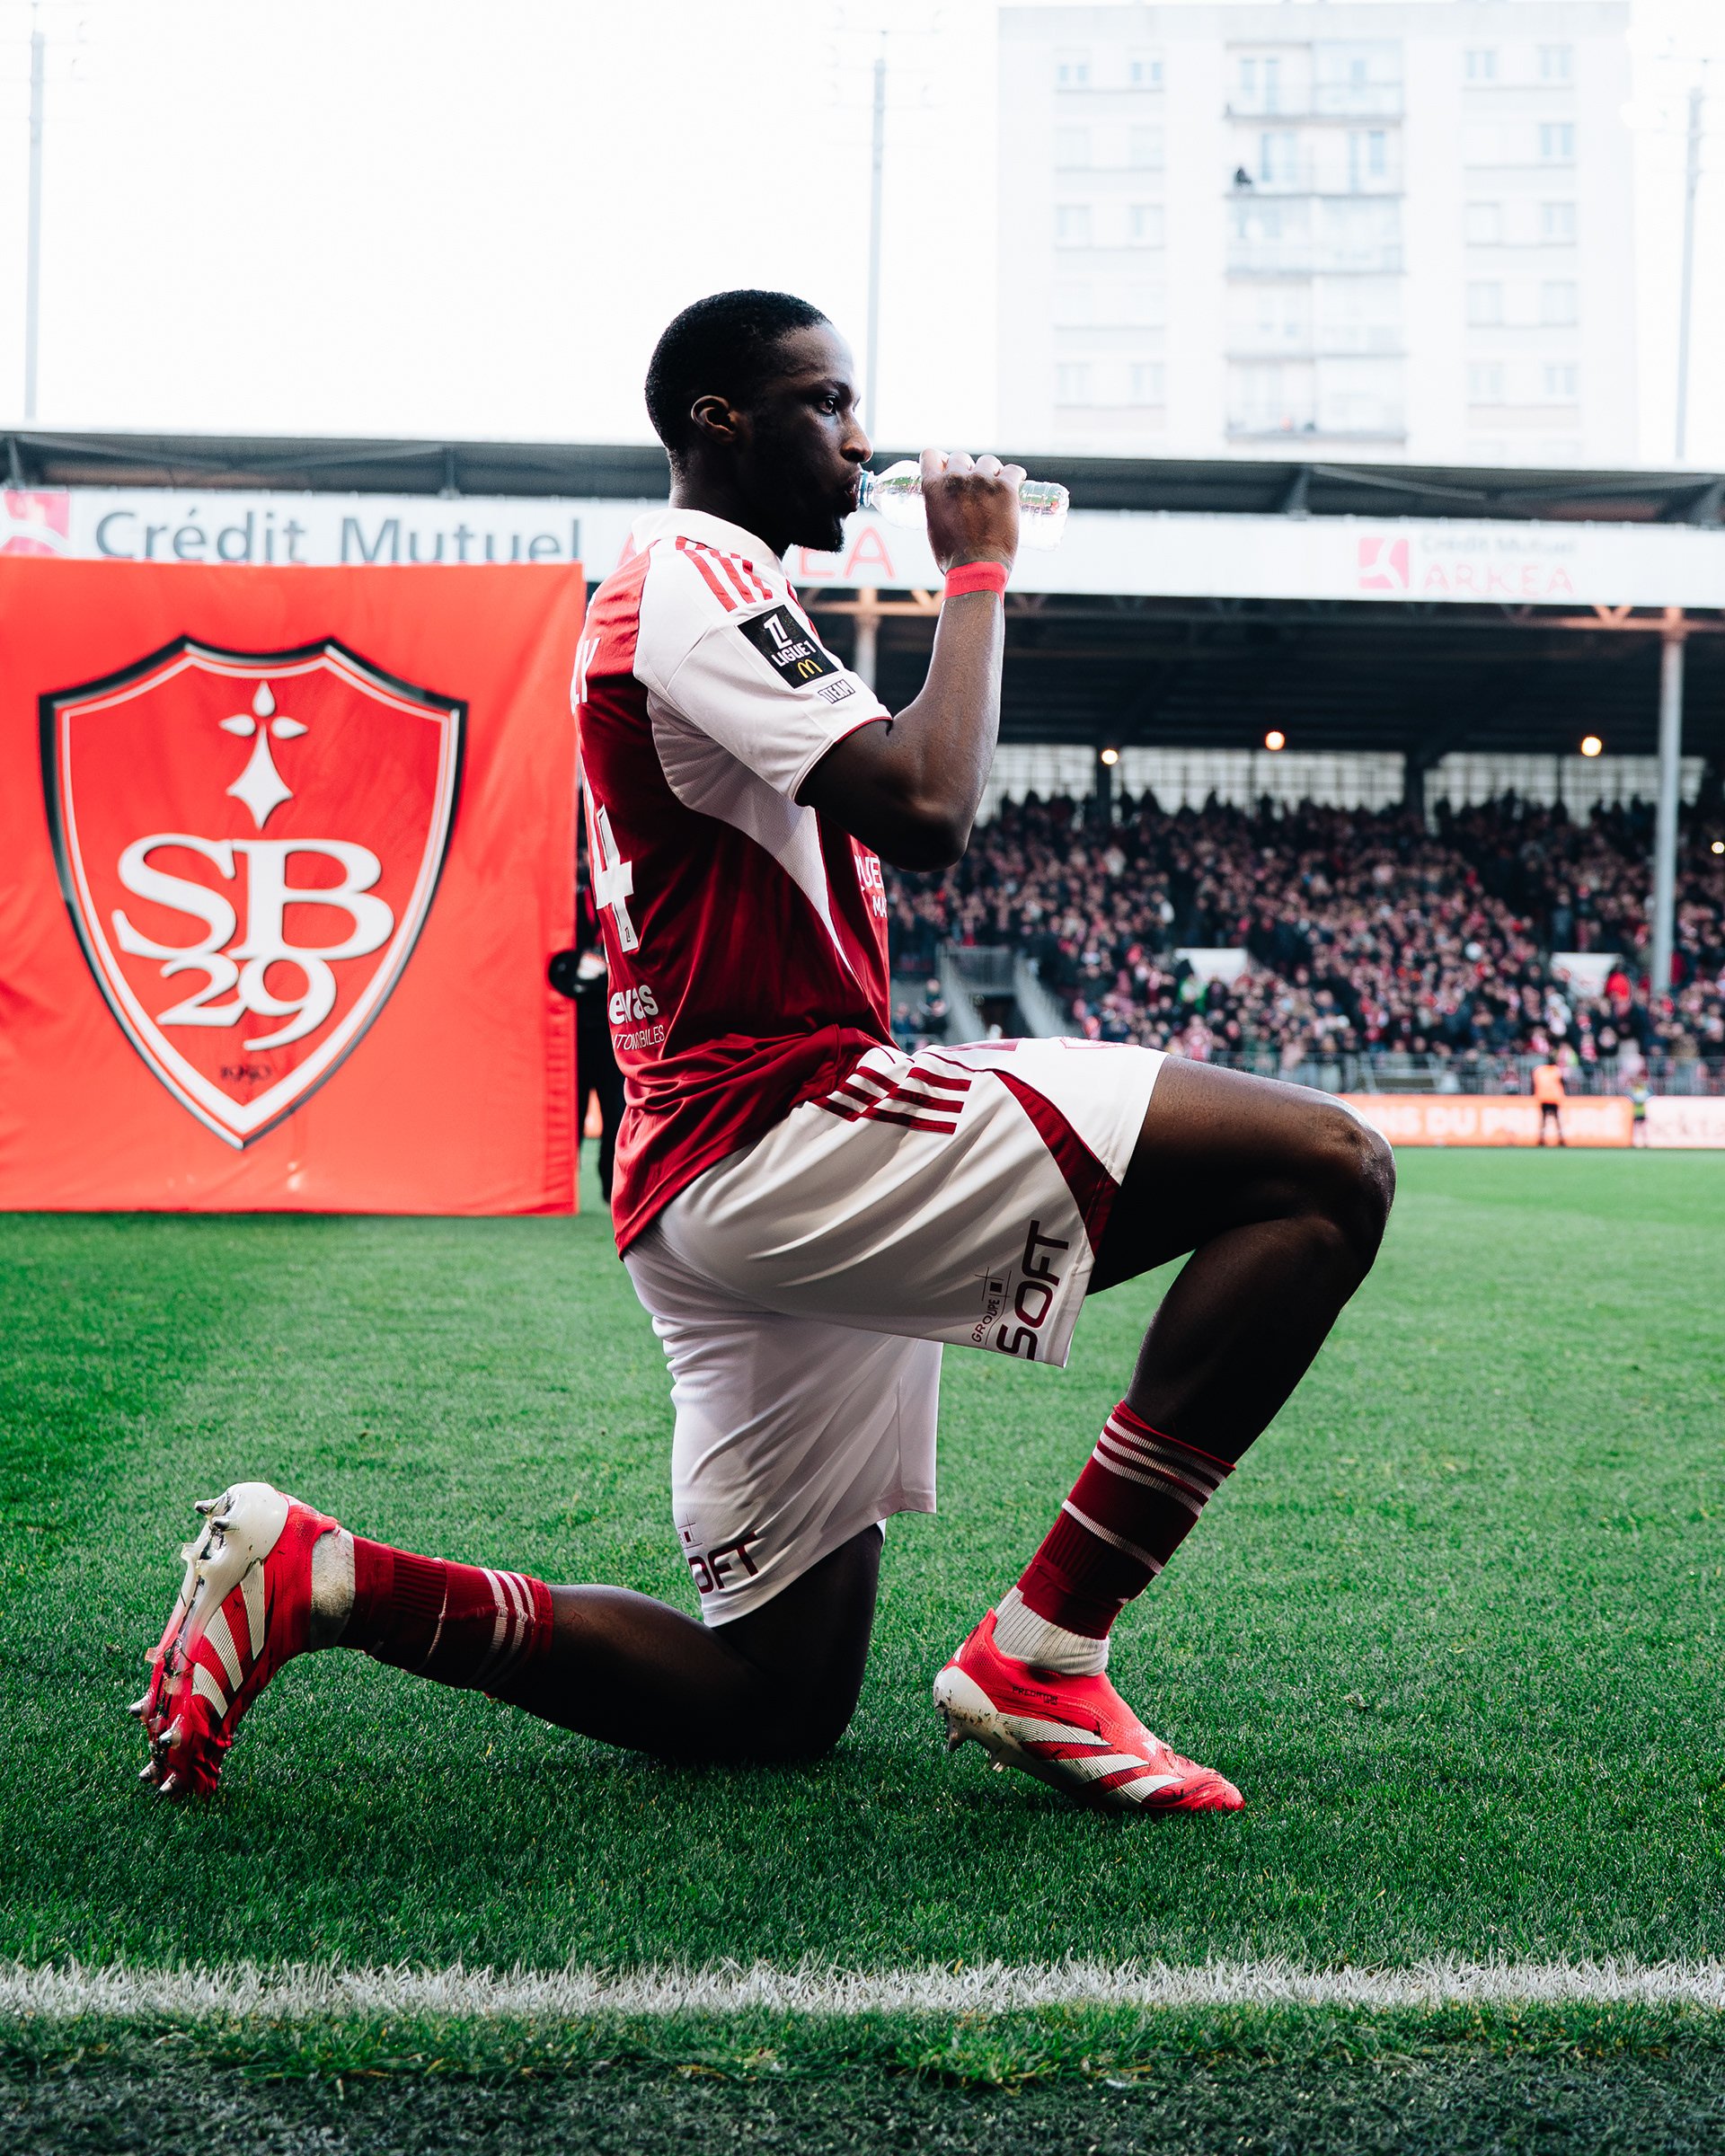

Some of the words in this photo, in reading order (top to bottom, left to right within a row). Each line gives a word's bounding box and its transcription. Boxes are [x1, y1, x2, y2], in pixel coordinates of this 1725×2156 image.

[96, 508, 307, 561] Crédit
[341, 516, 579, 562] Mutuel
[111, 832, 394, 961] SB
[155, 952, 338, 1052] 29
[1426, 1106, 1477, 1136] DU
[995, 1219, 1069, 1361] SOFT
[970, 1298, 1001, 1344] GROUPE
[687, 1531, 759, 1595] OFT
[1012, 1685, 1058, 1703] PREDATOR
